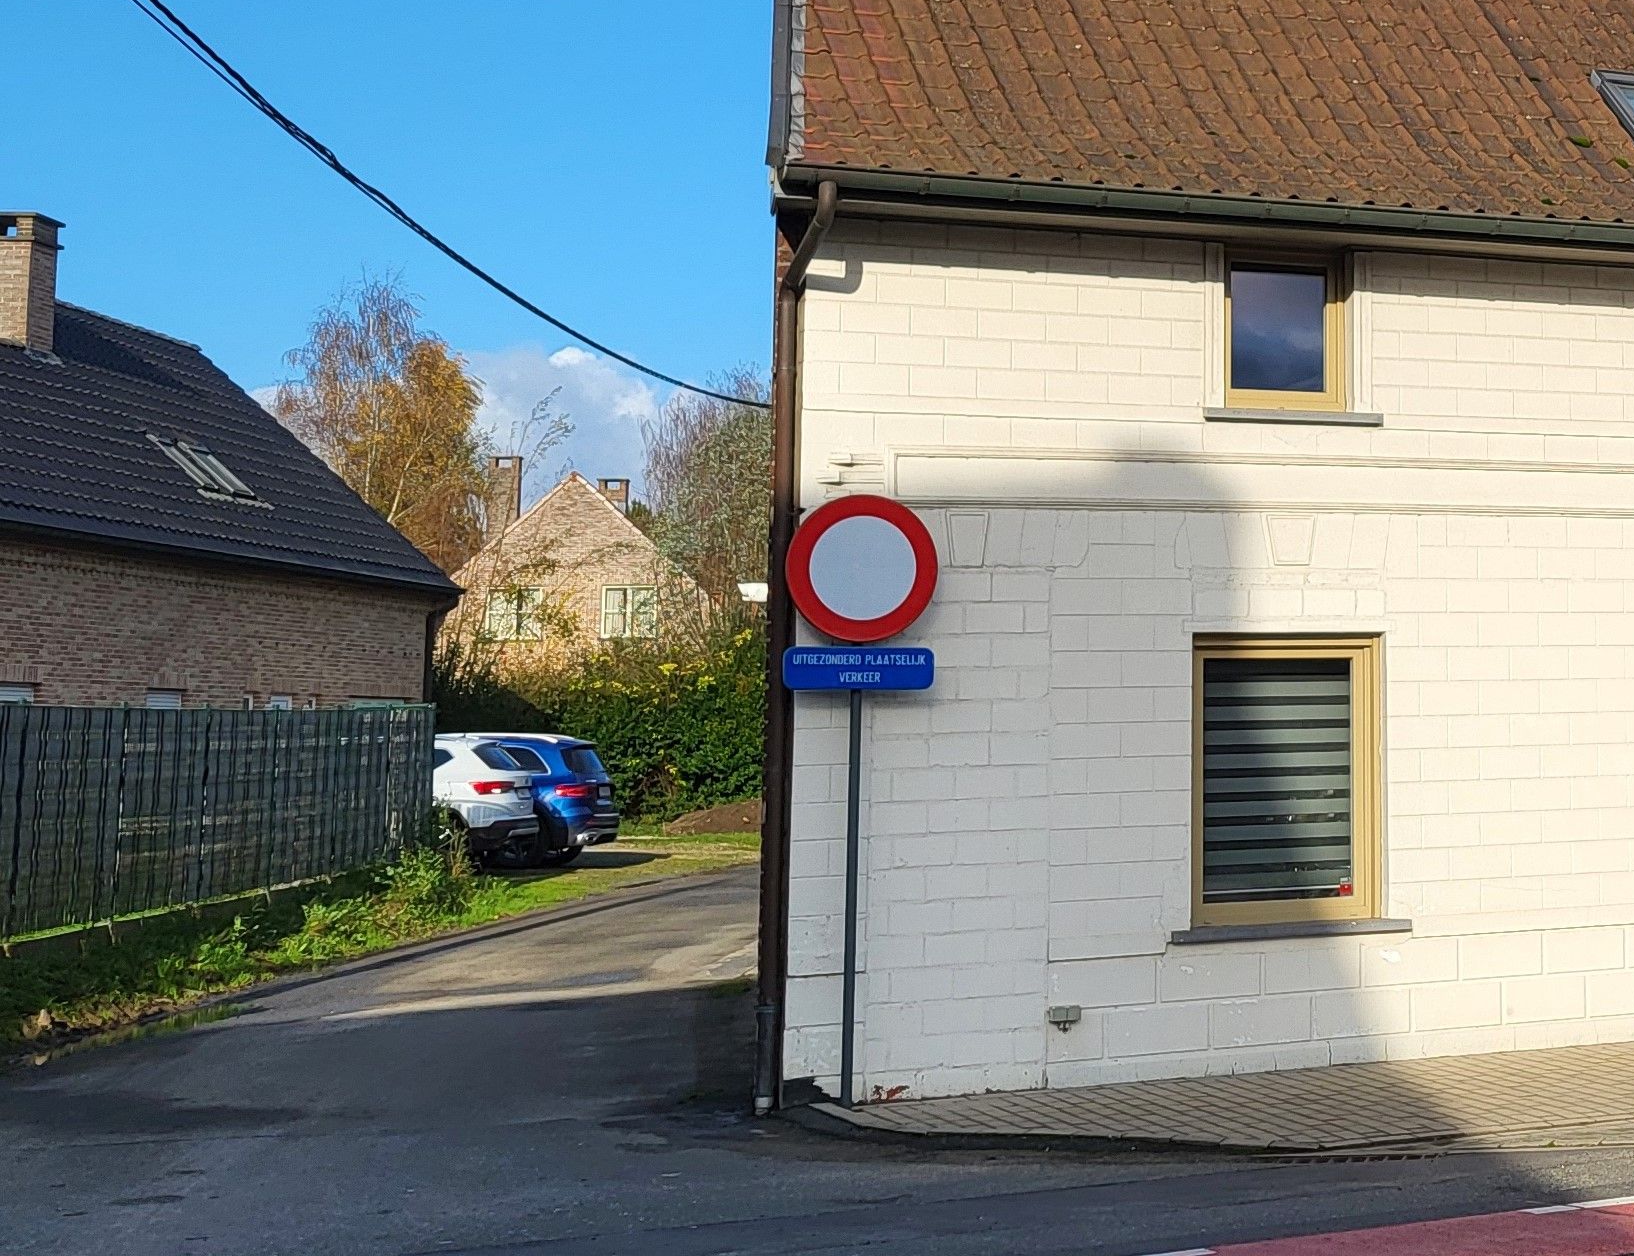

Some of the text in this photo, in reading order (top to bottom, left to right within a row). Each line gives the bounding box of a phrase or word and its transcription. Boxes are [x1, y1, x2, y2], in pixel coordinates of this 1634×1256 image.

[792, 654, 926, 665] UITGEZONDERD PLAATSELIJK
[839, 671, 881, 683] VERKEER
